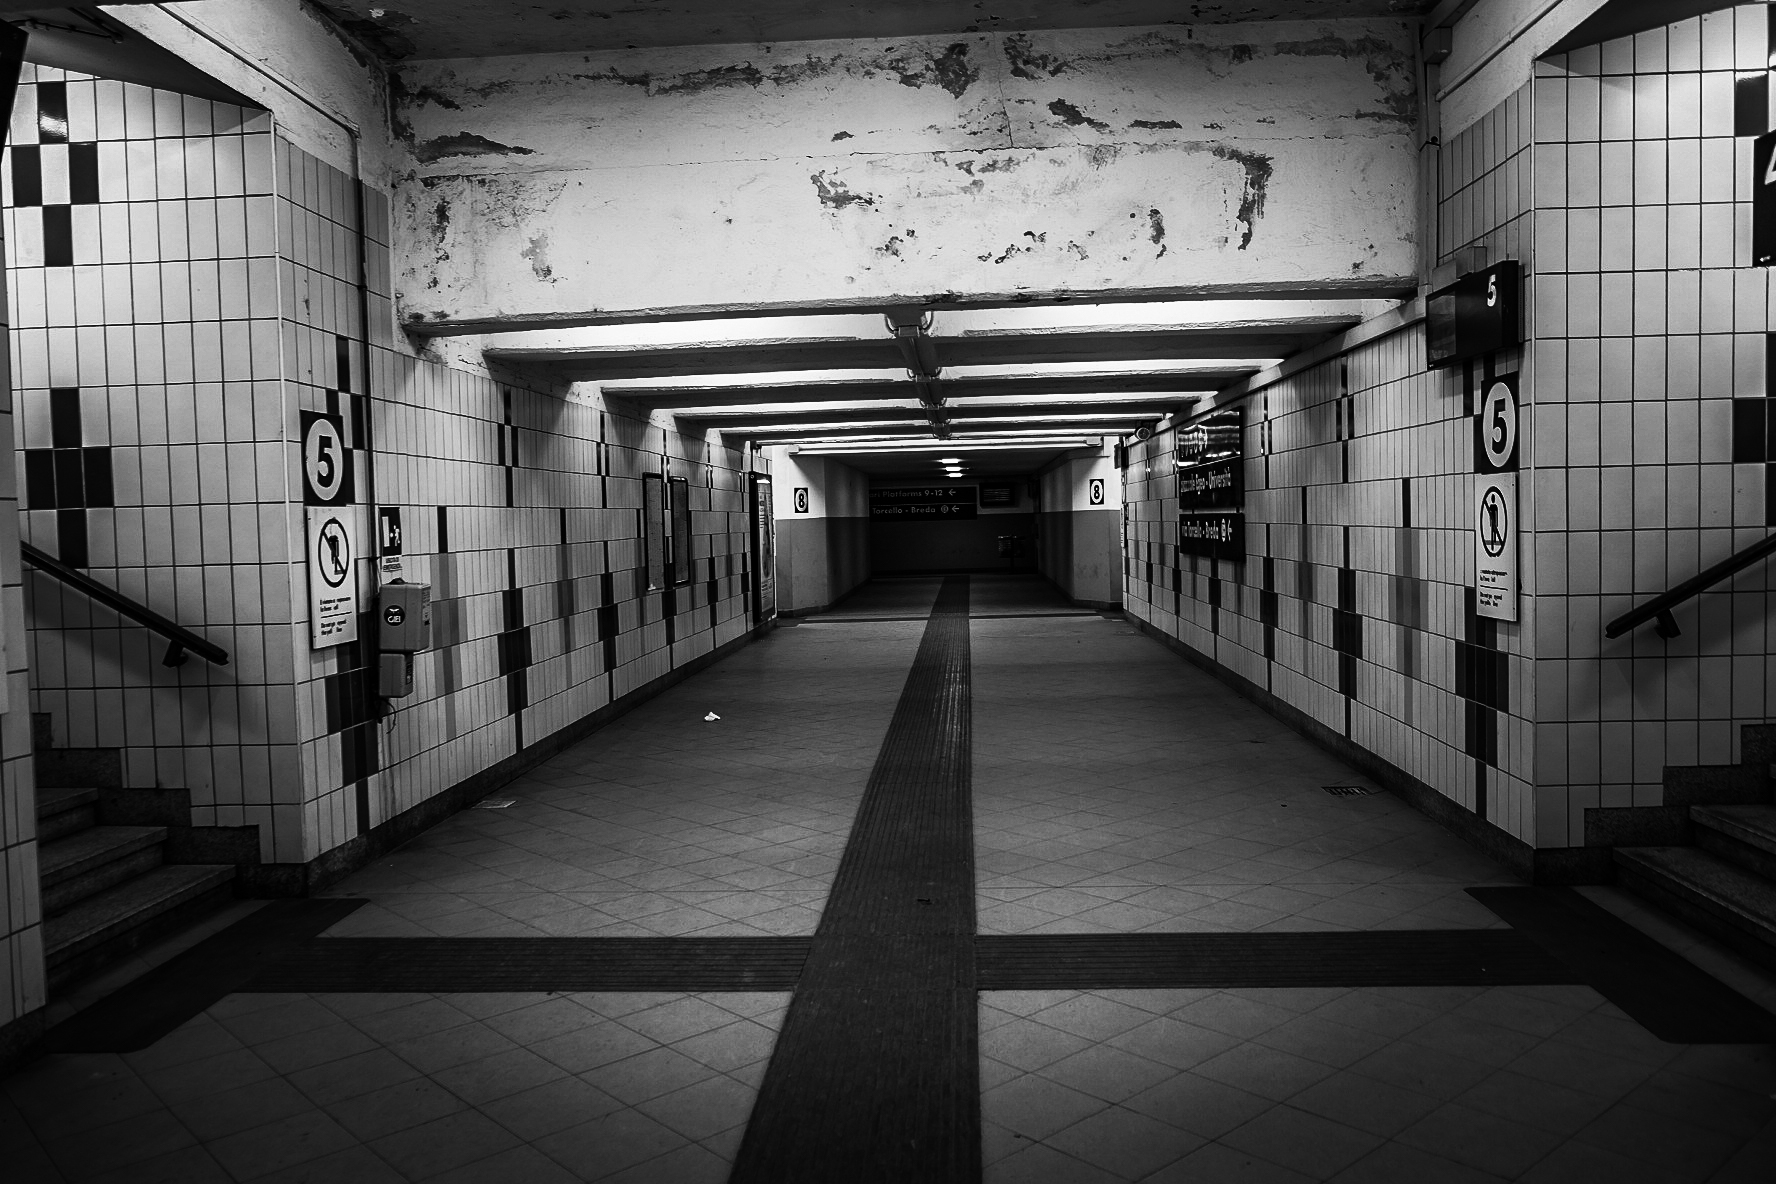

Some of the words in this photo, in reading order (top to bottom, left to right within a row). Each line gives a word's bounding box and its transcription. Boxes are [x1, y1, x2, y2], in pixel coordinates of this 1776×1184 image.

[1487, 274, 1497, 307] 5
[1491, 398, 1508, 455] 5
[317, 435, 334, 488] 5
[798, 492, 805, 508] 8
[882, 489, 923, 498] Platforms
[924, 489, 943, 497] 9-12
[1093, 483, 1100, 500] 8
[872, 506, 904, 515] Torcello
[911, 505, 936, 514] Breda
